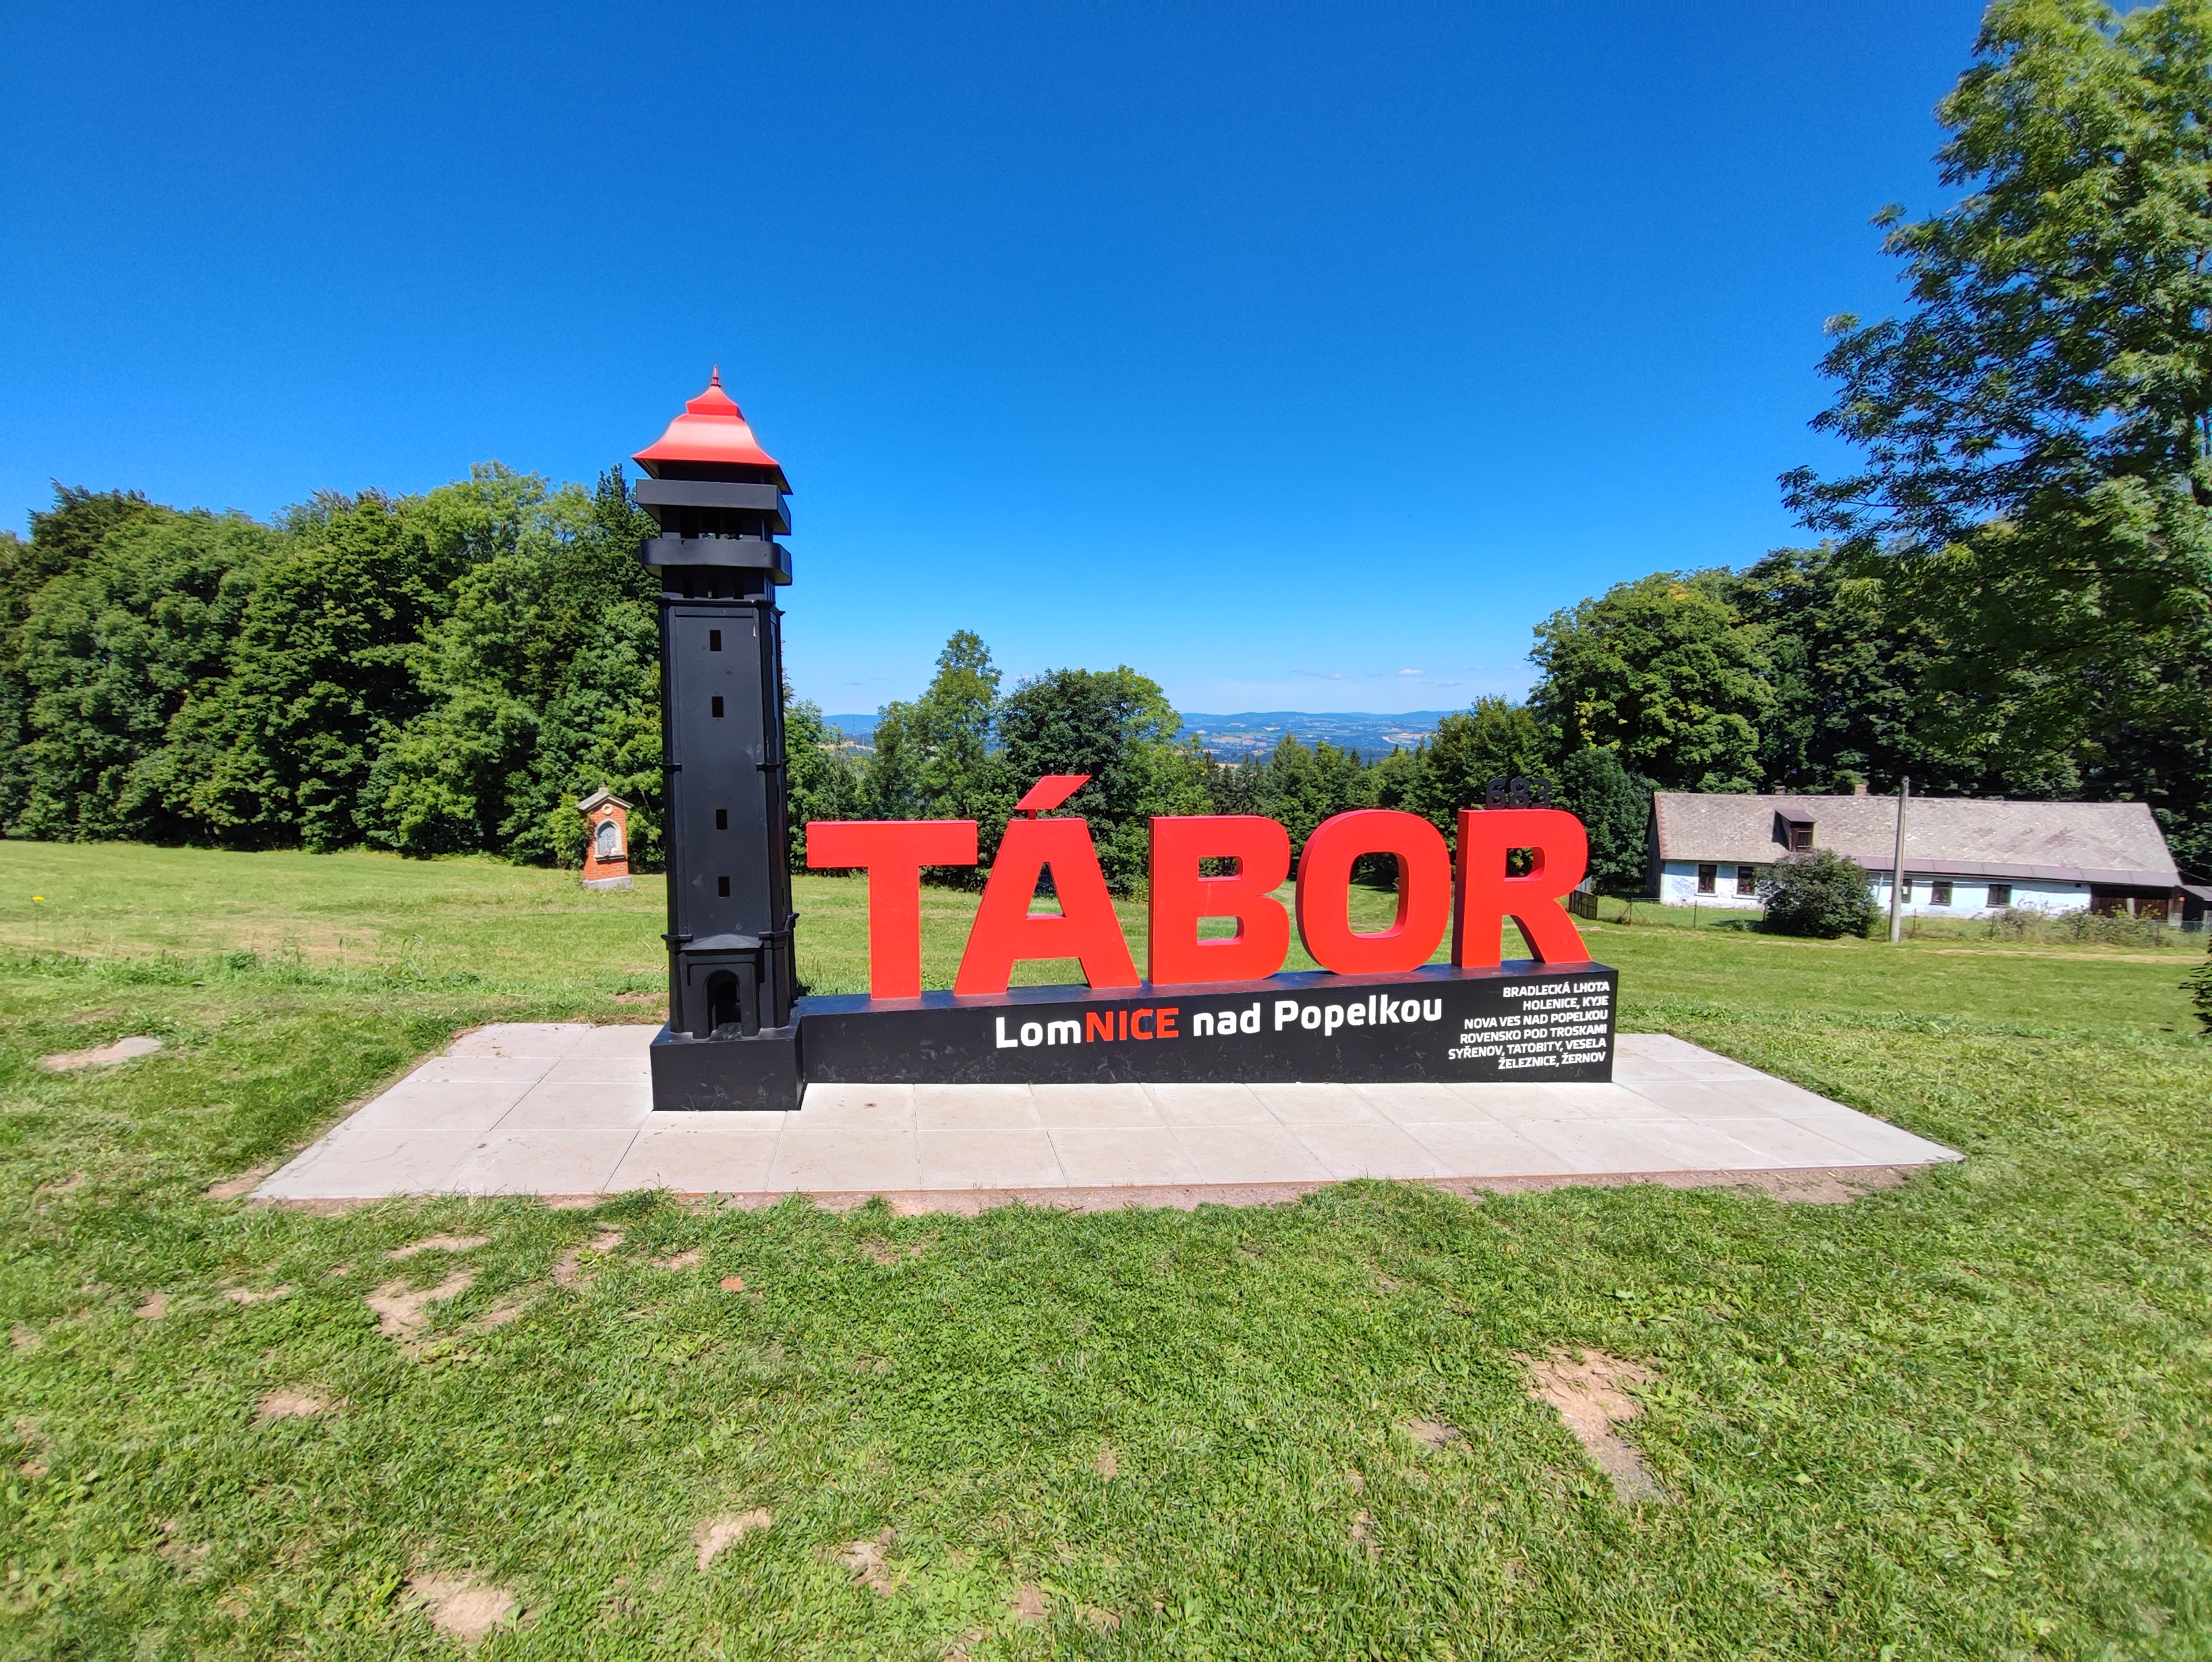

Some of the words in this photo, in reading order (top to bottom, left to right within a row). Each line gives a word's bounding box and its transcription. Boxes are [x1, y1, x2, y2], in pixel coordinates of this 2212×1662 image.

[1486, 778, 1551, 809] 683
[807, 774, 1593, 1000] TÁBOR
[1503, 981, 1570, 998] BRADLECKÁ
[1574, 981, 1610, 993] LHOTA
[1523, 998, 1580, 1010] HOLENICE,
[1583, 996, 1609, 1006] KYJE
[995, 1007, 1179, 1048] LomNICE
[1193, 1002, 1261, 1037] nad
[1275, 994, 1443, 1036] Popelkou
[1499, 1016, 1521, 1027] VES
[1523, 1014, 1548, 1025] NAD
[1551, 1010, 1608, 1023] POPELKOU
[1460, 1030, 1521, 1043] ROVENSKO
[1524, 1028, 1547, 1039] POD
[1550, 1024, 1607, 1037] TROSKAMI
[1449, 1045, 1505, 1060] SYŘENOV,
[1507, 1041, 1563, 1054] TATOBITY,
[1498, 1055, 1559, 1070] ŽELEZNICE,
[1562, 1052, 1606, 1064] ŽERNOV
